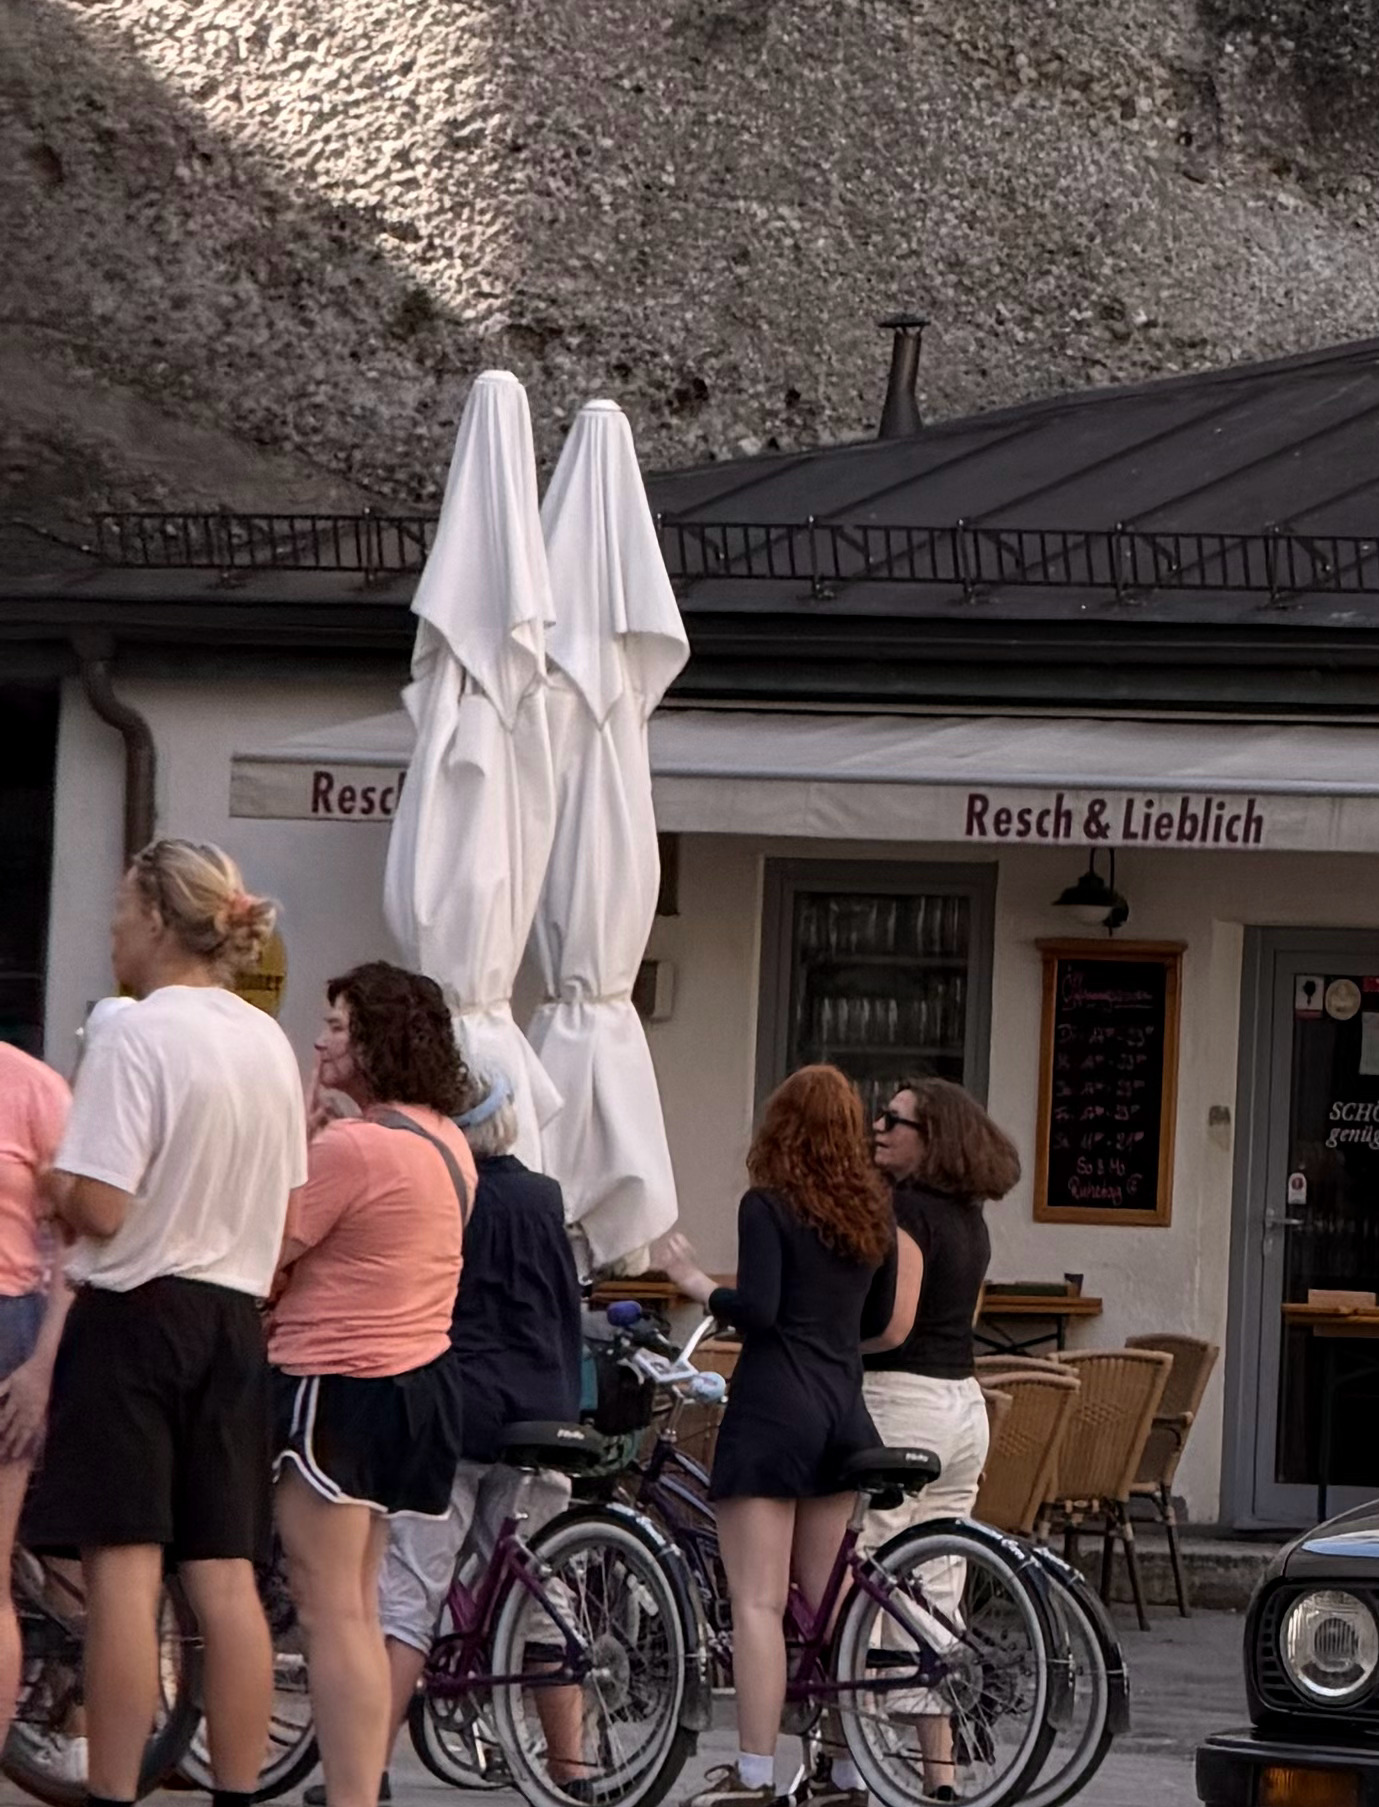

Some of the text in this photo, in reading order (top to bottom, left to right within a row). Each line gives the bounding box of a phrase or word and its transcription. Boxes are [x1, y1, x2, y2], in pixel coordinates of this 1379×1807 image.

[965, 792, 1264, 844] Resch & Lieblich
